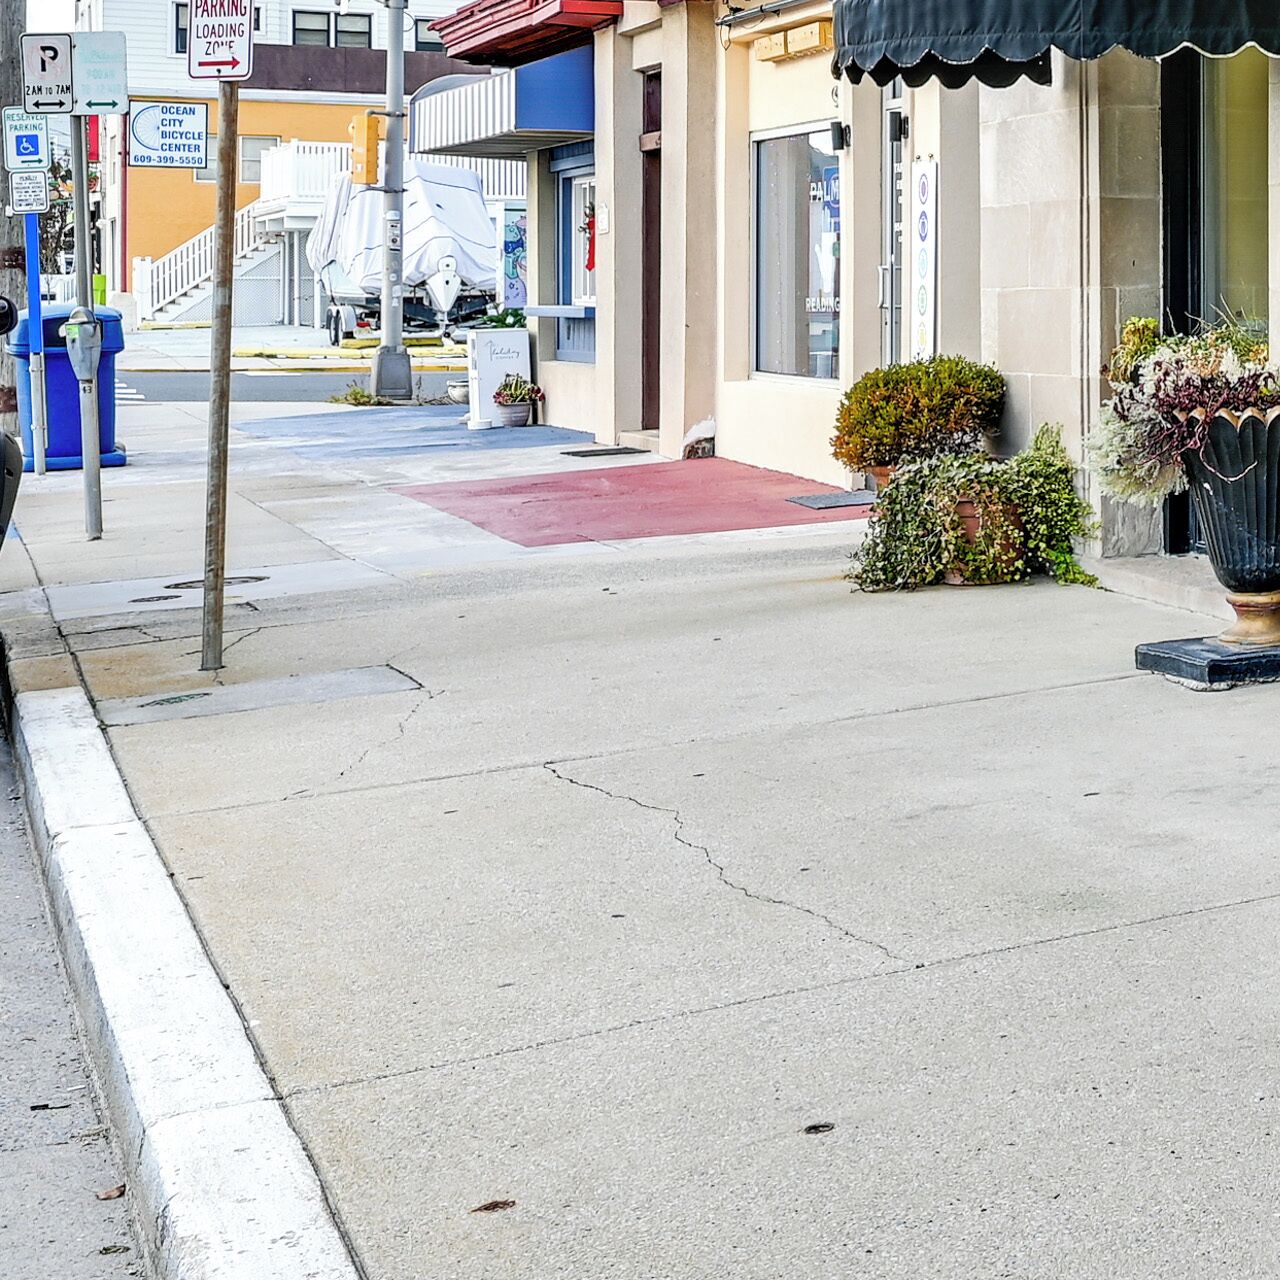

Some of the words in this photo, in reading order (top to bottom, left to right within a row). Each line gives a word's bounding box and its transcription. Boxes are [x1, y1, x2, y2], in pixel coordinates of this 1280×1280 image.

[196, 22, 245, 39] LOADING
[160, 105, 196, 116] OCEAN
[9, 122, 44, 132] PARKING
[160, 118, 184, 128] CITY
[160, 130, 204, 141] BICYCLE
[160, 142, 201, 153] CENTER
[133, 154, 203, 165] 609-399-5550
[810, 181, 840, 203] PALM
[805, 296, 840, 313] READING
